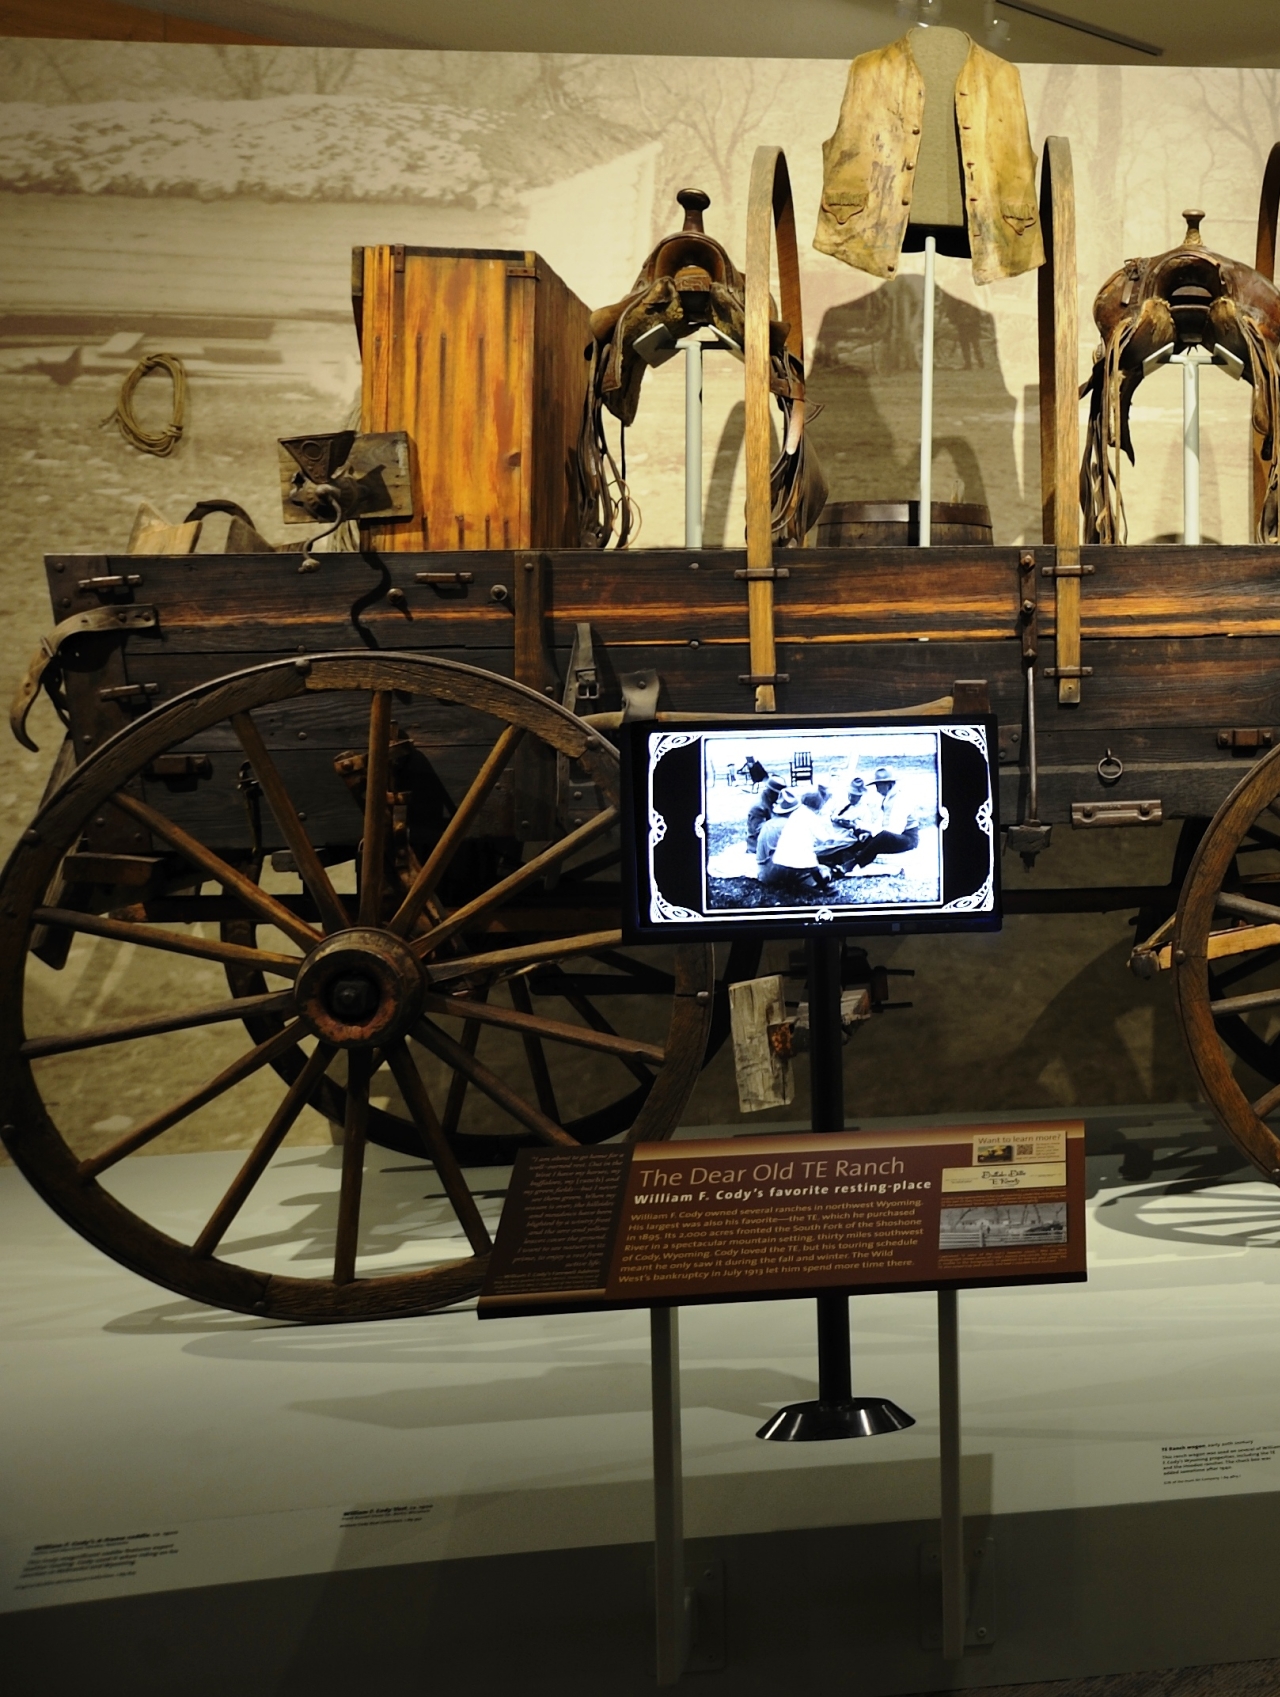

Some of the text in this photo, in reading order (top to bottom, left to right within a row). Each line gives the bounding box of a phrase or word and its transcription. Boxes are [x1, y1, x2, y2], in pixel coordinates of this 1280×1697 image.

[640, 1156, 904, 1187] The Dear Old TE Ranch
[634, 1180, 931, 1204] William F. Cody's favorite resting-place
[630, 1213, 668, 1221] William
[678, 1210, 703, 1219] Cody
[704, 1208, 738, 1217] owned
[739, 1206, 773, 1215] several
[774, 1205, 812, 1213] ranches
[825, 1201, 874, 1210] northwest
[646, 1222, 679, 1231] largest
[703, 1219, 723, 1227] also
[821, 1212, 850, 1220] which
[866, 1208, 915, 1219] purchased
[736, 1226, 772, 1234] fronted
[774, 1225, 791, 1233] the
[792, 1223, 821, 1232] South
[823, 1222, 843, 1230] Fork
[845, 1221, 856, 1229] of
[875, 1219, 922, 1227] Shoshone
[621, 1254, 633, 1262] of
[714, 1248, 739, 1257] Cody
[740, 1246, 767, 1255] loved
[838, 1241, 874, 1249] touring
[876, 1238, 918, 1247] schedule
[671, 1239, 726, 1249] spectacular
[728, 1237, 776, 1245] mountain
[817, 1233, 844, 1241] thirty
[874, 1228, 923, 1237] southwest
[620, 1264, 652, 1272] meant
[669, 1261, 691, 1270] only
[724, 1258, 757, 1266] during
[759, 1256, 776, 1264] the
[795, 1254, 815, 1262] and
[871, 1249, 893, 1257] Wild
[653, 1271, 709, 1281] bankruptcy
[722, 1268, 742, 1278] July
[744, 1268, 763, 1276] 1913
[765, 1266, 778, 1274] let
[802, 1263, 832, 1273] spend
[834, 1262, 860, 1270] more
